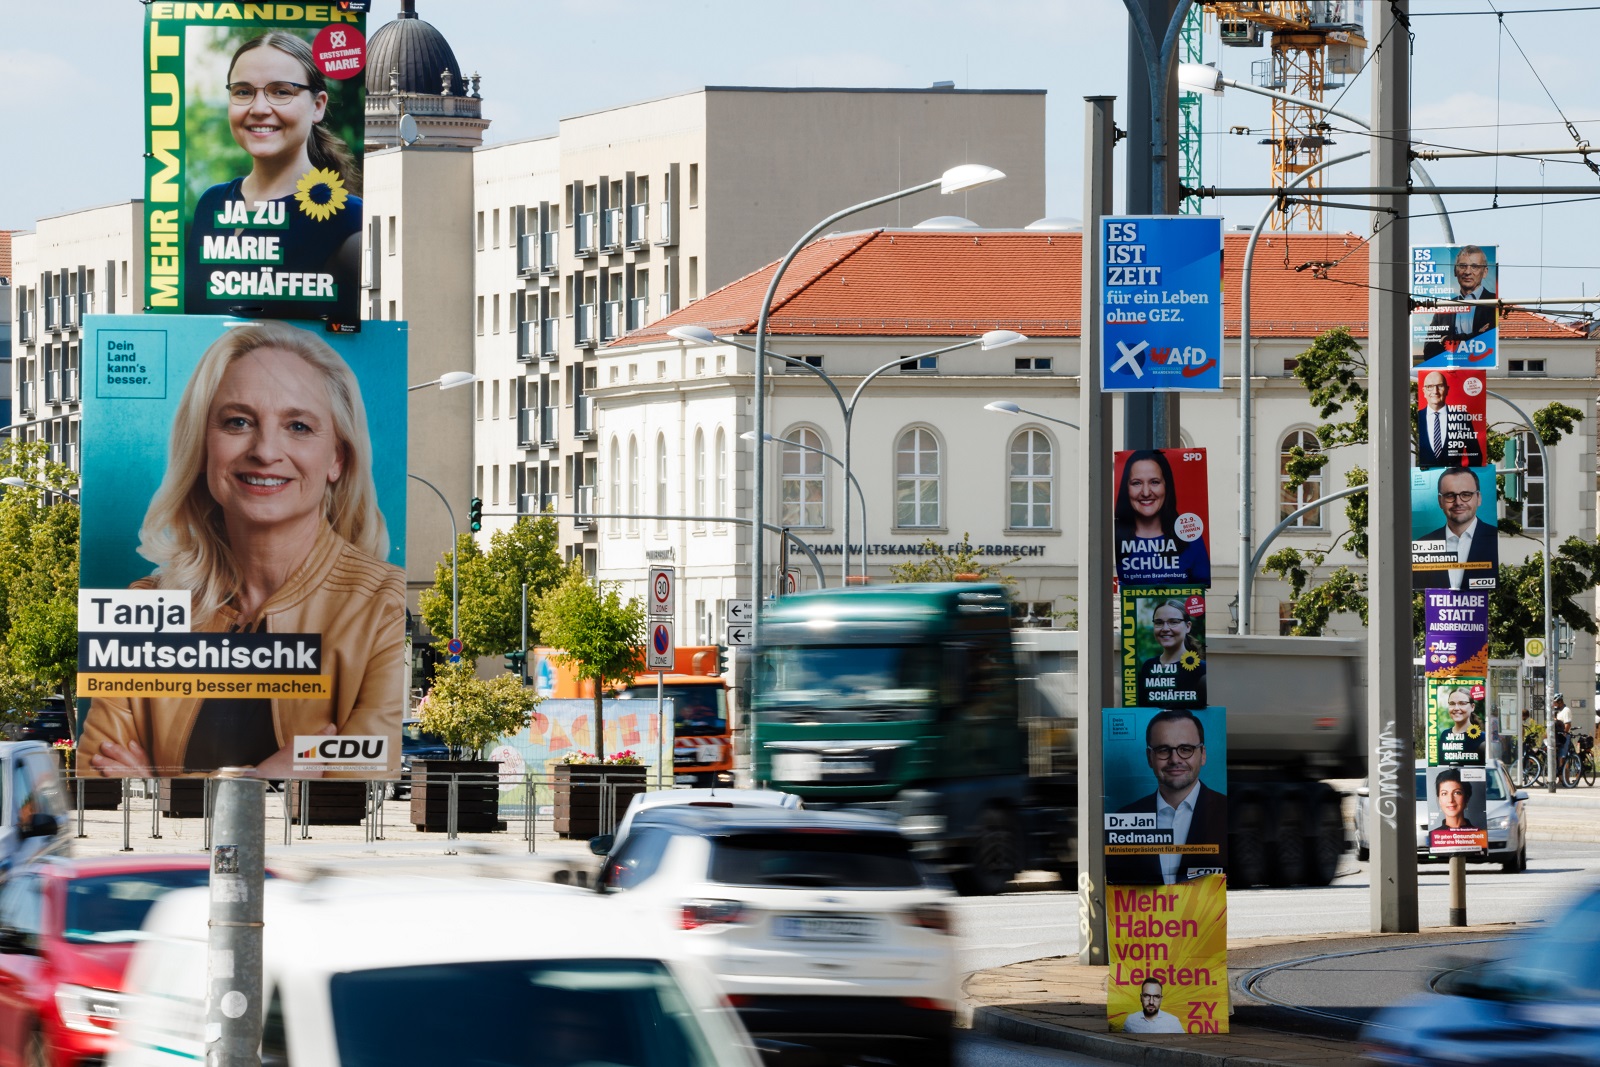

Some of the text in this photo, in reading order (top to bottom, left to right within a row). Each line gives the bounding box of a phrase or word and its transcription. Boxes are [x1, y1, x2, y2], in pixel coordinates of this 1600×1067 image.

[151, 3, 358, 23] EINANDER
[319, 47, 362, 60] ERSTSTIMME
[325, 57, 360, 72] MARIE
[150, 22, 180, 307] MEHR MUT
[217, 201, 285, 225] JA ZU
[1108, 223, 1137, 242] ES
[203, 236, 280, 260] MARIE
[1108, 245, 1145, 264] IST
[1415, 249, 1431, 261] ES
[1415, 261, 1435, 273] IST
[210, 267, 334, 297] SCHÄFFER
[1108, 267, 1160, 286] ZEIT
[1415, 274, 1444, 285] ZEIT
[1414, 285, 1454, 294] für einen
[1107, 290, 1209, 304] für ein Leben
[1107, 309, 1185, 322] ohne GEZ.
[107, 340, 134, 351] Dein
[1457, 339, 1486, 353] AfD
[107, 351, 136, 362] Land
[1167, 346, 1207, 365] AfD
[107, 374, 151, 385] besser.
[1448, 413, 1483, 421] WOIDKE
[1448, 423, 1470, 431] WILL,
[1448, 431, 1478, 439] WÄHLT
[1183, 452, 1202, 462] SPD
[978, 545, 1046, 556] ERBRECHT
[1121, 539, 1177, 554] MANJA
[1412, 543, 1444, 551] Dr. Jan
[1122, 553, 1180, 570] SCHÜLE
[1412, 554, 1457, 563] Redmann
[1130, 572, 1142, 580] geht
[658, 581, 667, 595] 30
[1123, 588, 1202, 596] EINANDER
[1429, 594, 1485, 607] TEILHABE
[91, 597, 186, 632] Tanja
[656, 605, 668, 613] ZONE
[1439, 609, 1475, 621] STATT
[1430, 623, 1484, 632] AUSGRENZUNG
[88, 638, 317, 669] Mutschischk
[1123, 597, 1136, 706] MEHR MUT
[1531, 643, 1539, 653] H
[655, 656, 667, 665] ZONE
[1150, 664, 1177, 674] JA ZU
[88, 677, 326, 696] Brandenburg besser machen.
[1145, 677, 1176, 687] MARIE
[1149, 689, 1197, 701] SCHÄFFER
[1429, 685, 1438, 763] MEHR MUT
[504, 712, 667, 752] RACHEN
[1446, 733, 1465, 741] JA ZU
[319, 740, 384, 759] CDU
[1442, 742, 1463, 750] MARIE
[1444, 751, 1478, 760] SCHÄFFER
[1109, 816, 1154, 827] Dr. Jan
[1109, 832, 1172, 844] Redmann
[1114, 890, 1179, 912] Mehr
[1115, 915, 1198, 938] Haben
[1116, 942, 1168, 961] vom
[1115, 963, 1218, 986] Leisten.
[1187, 1001, 1218, 1019] ZY
[1187, 1020, 1219, 1033] ON
